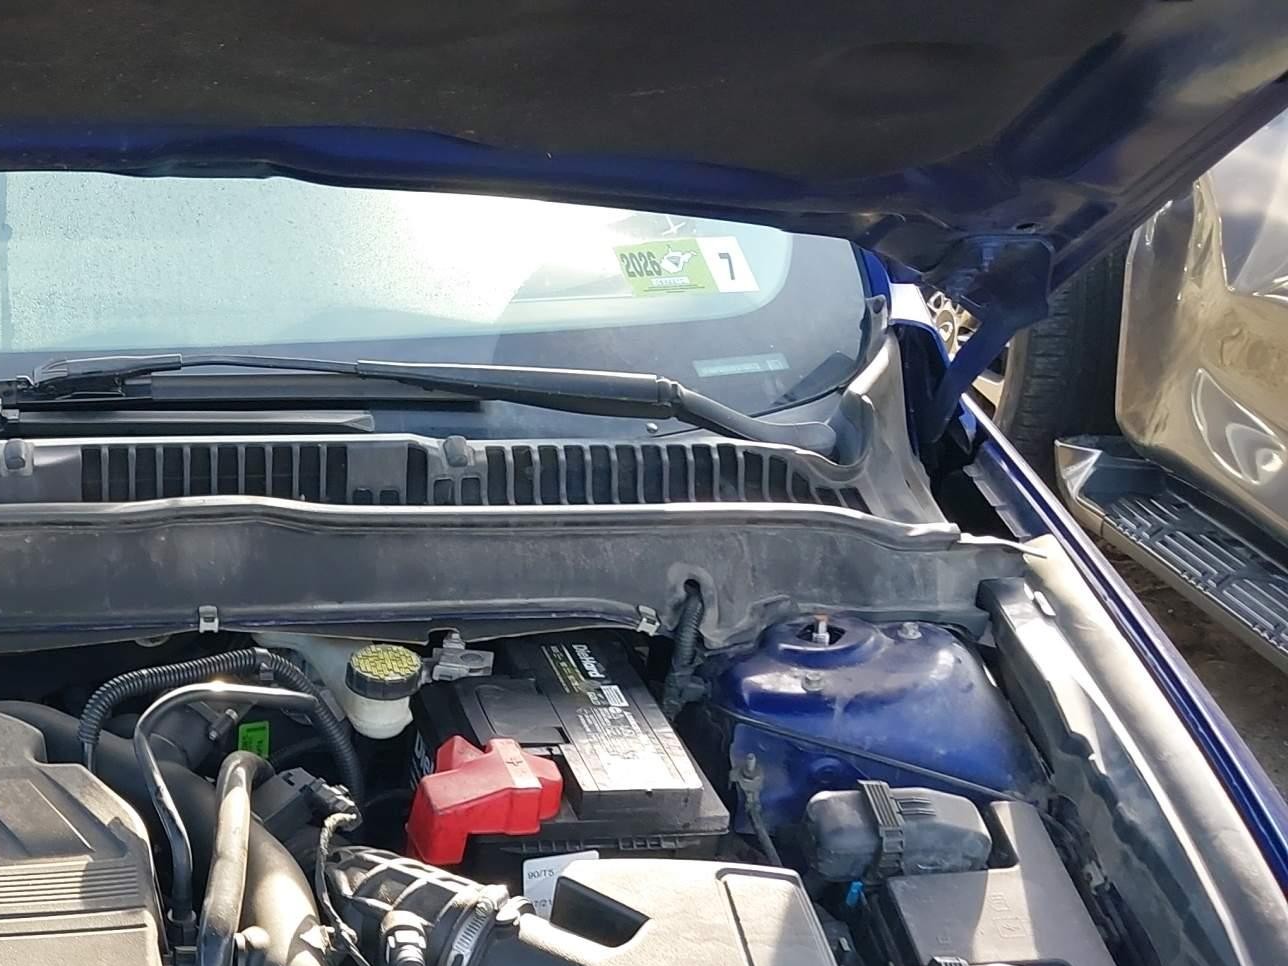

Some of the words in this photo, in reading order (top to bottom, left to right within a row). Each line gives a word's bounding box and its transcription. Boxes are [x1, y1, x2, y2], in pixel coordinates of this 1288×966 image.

[620, 251, 663, 278] 2026
[718, 252, 736, 281] 7
[572, 643, 606, 678] DieHard
